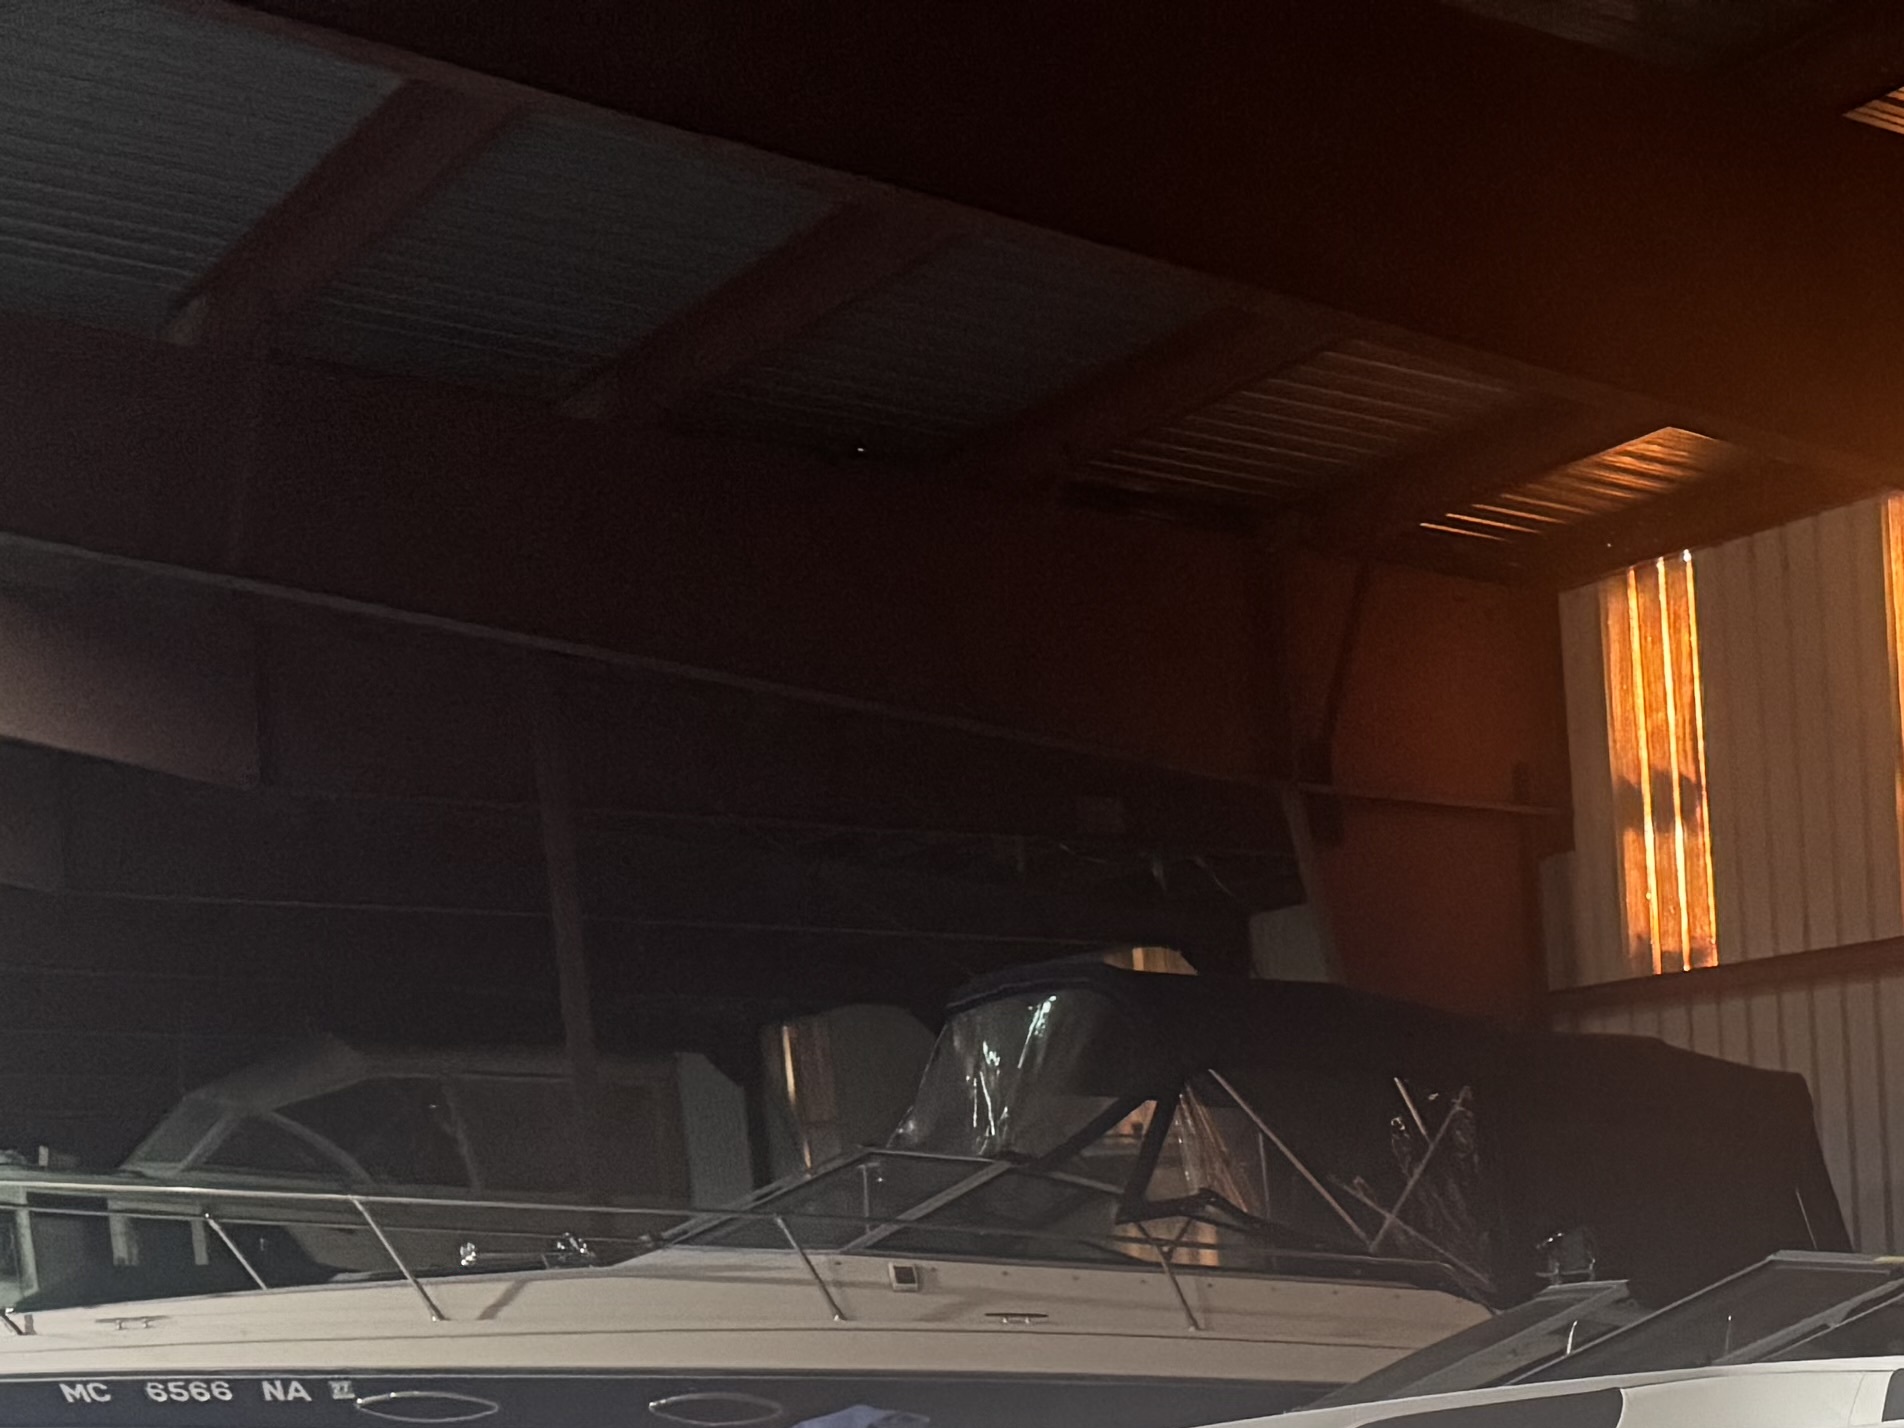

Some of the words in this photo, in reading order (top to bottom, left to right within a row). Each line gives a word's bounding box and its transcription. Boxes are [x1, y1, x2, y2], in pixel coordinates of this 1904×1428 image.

[59, 1382, 112, 1403] MC
[145, 1381, 233, 1402] 6566
[261, 1380, 312, 1401] NA
